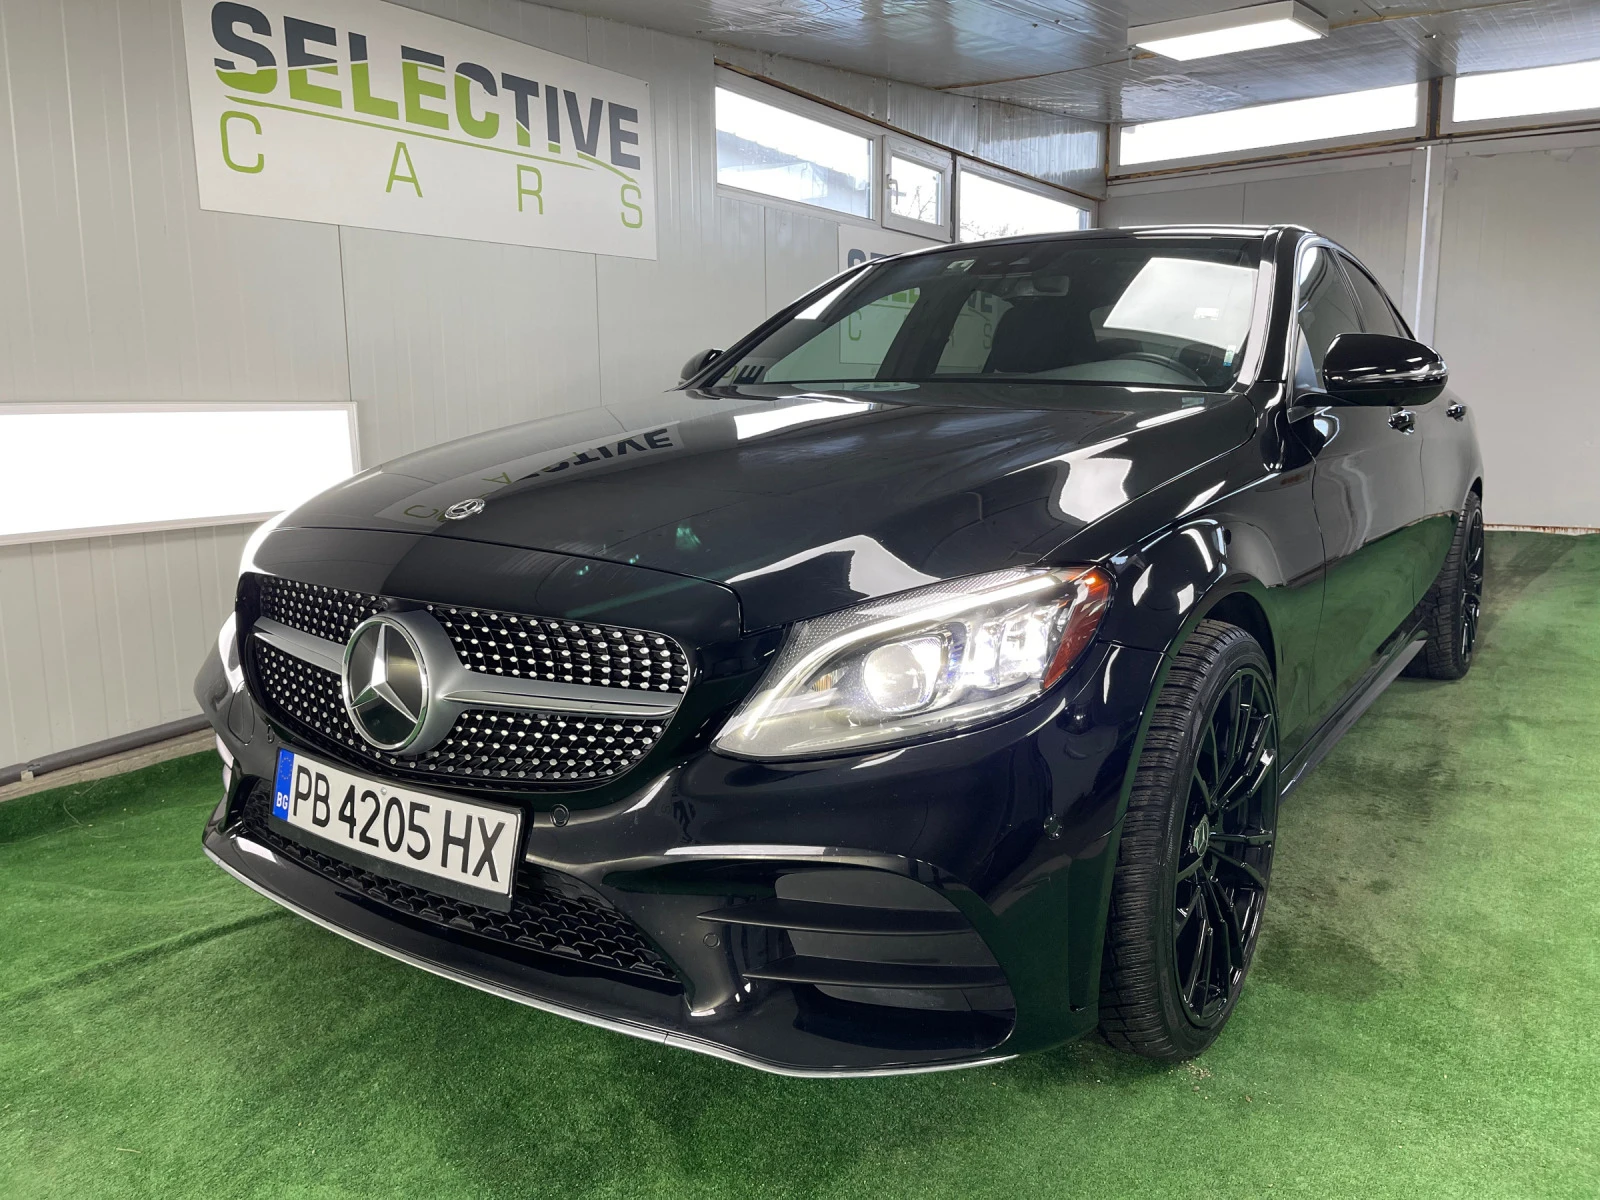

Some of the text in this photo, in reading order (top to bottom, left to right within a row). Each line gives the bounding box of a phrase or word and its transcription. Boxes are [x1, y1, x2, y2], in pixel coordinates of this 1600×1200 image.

[211, 1, 641, 170] SELECTIVE
[220, 110, 643, 229] CARS
[276, 792, 288, 810] BG
[293, 764, 505, 882] PB 4205 HX
